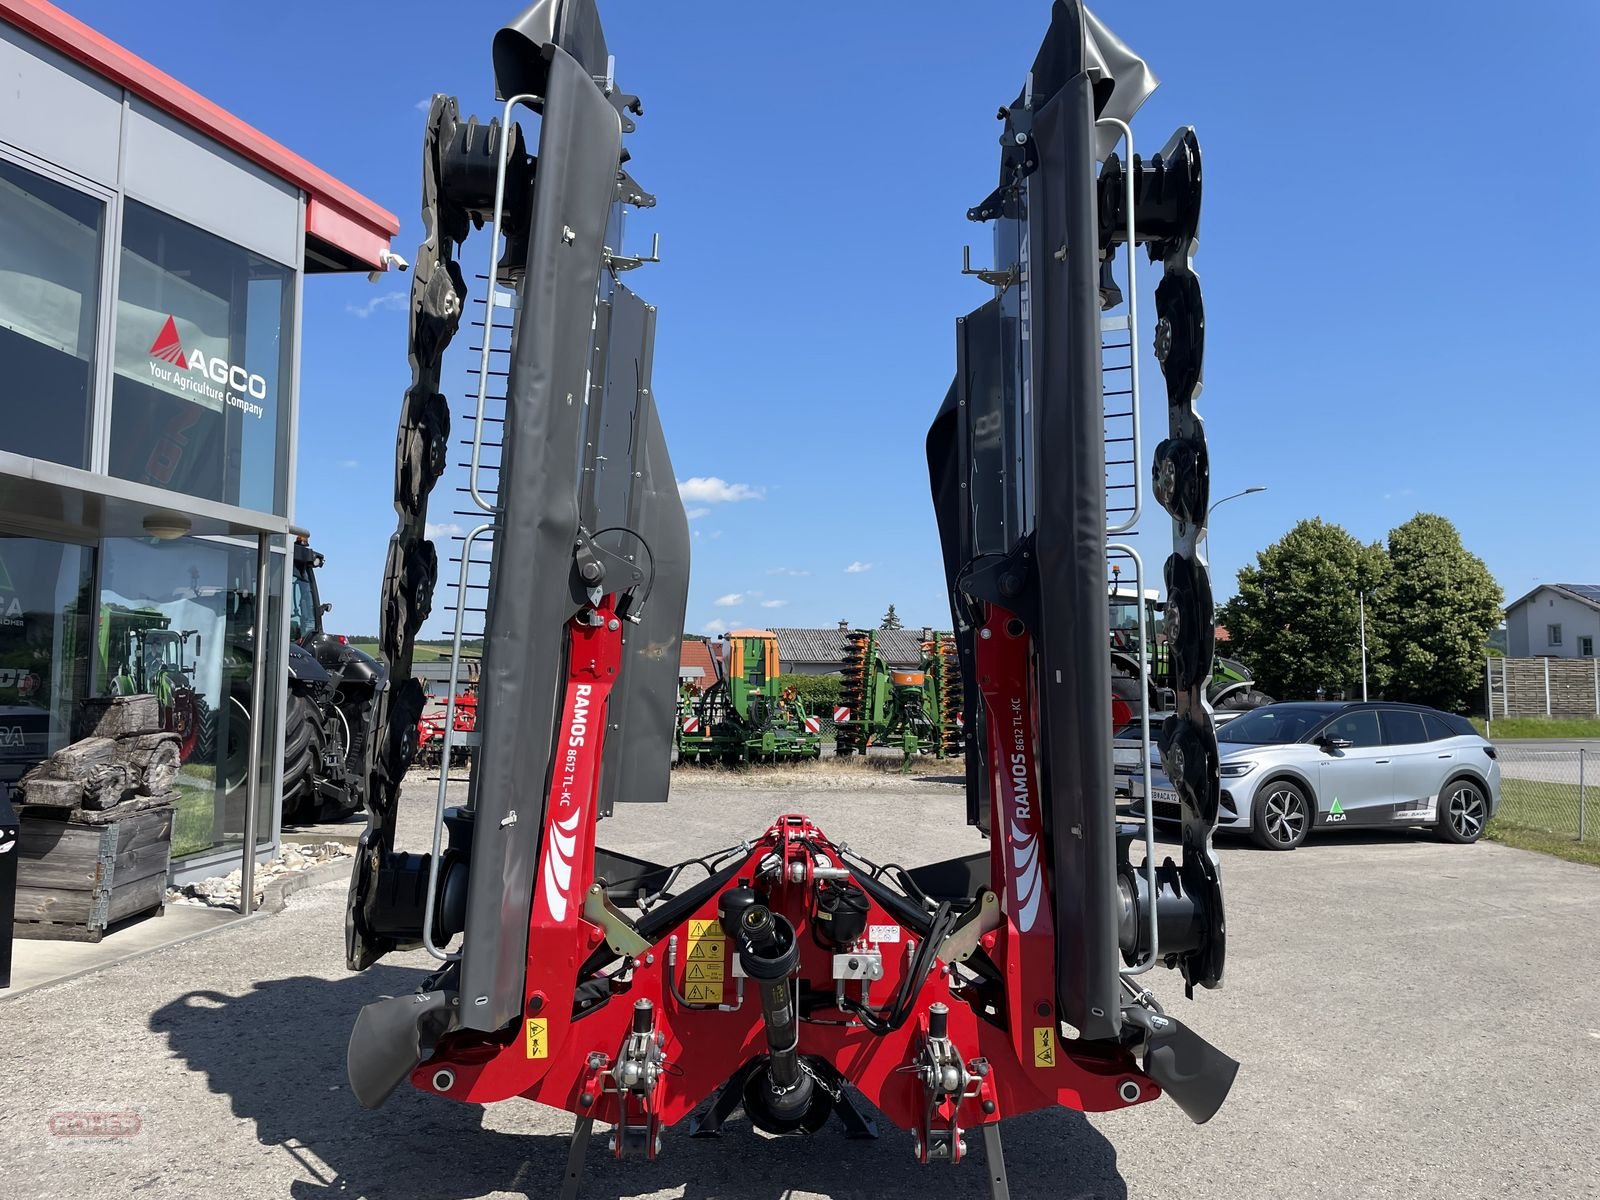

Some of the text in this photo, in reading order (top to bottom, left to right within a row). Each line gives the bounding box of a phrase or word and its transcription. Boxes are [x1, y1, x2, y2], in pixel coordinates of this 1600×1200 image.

[149, 361, 264, 419] Your Agriculture Company
[187, 348, 266, 400] AGCO
[560, 684, 592, 807] RAMOS 8612 TL-KC
[1011, 697, 1031, 819] RAMOS 8612 TL-KC
[1325, 814, 1347, 822] ACA
